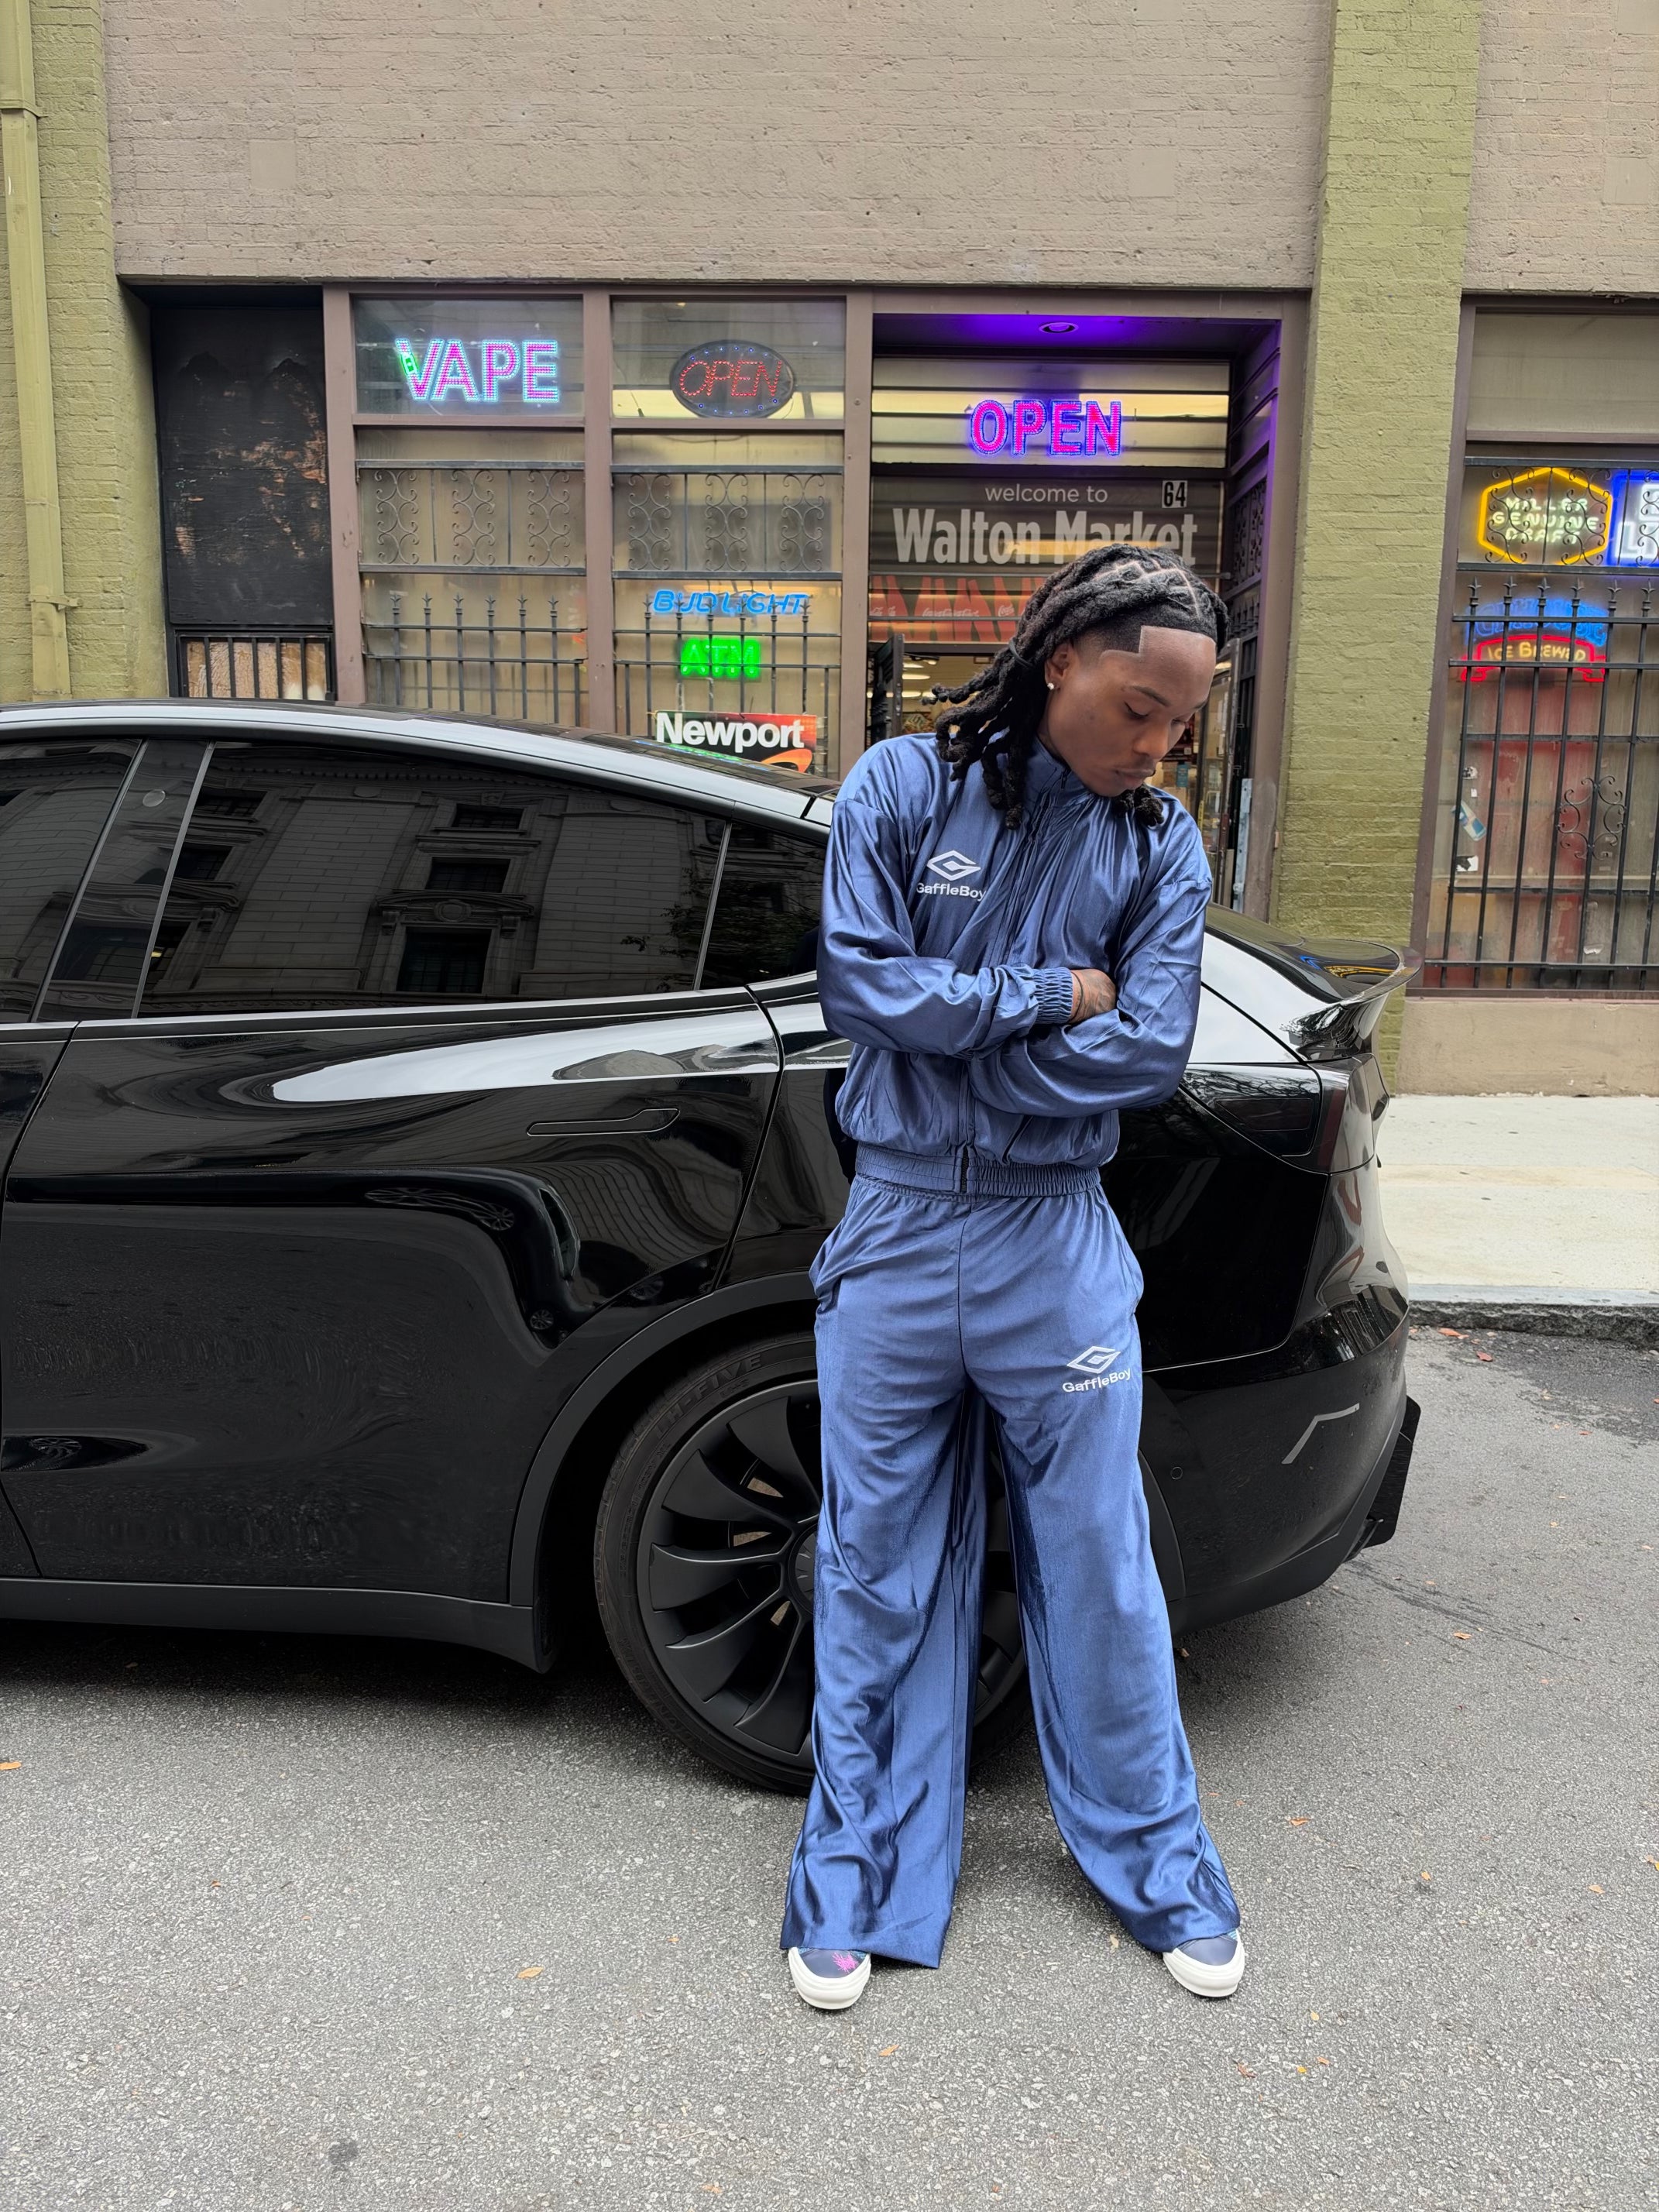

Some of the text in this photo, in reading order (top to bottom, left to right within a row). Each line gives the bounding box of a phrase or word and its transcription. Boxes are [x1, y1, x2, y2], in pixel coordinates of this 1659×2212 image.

[395, 338, 559, 402] VAPE
[679, 361, 782, 397] OPEN
[970, 400, 1121, 455] OPEN
[985, 483, 1108, 503] welcome to
[1163, 481, 1187, 507] 64
[1505, 497, 1589, 511] MILLER
[1492, 511, 1599, 531] GENUINE
[892, 507, 1041, 564] Walton
[1505, 528, 1581, 544] DRAFT
[653, 589, 809, 614] BUD LIGHT
[681, 637, 760, 677] ATM
[656, 713, 805, 753] Newport
[916, 883, 986, 902] GaffleBoy
[1062, 1368, 1131, 1393] GaffleBoy
